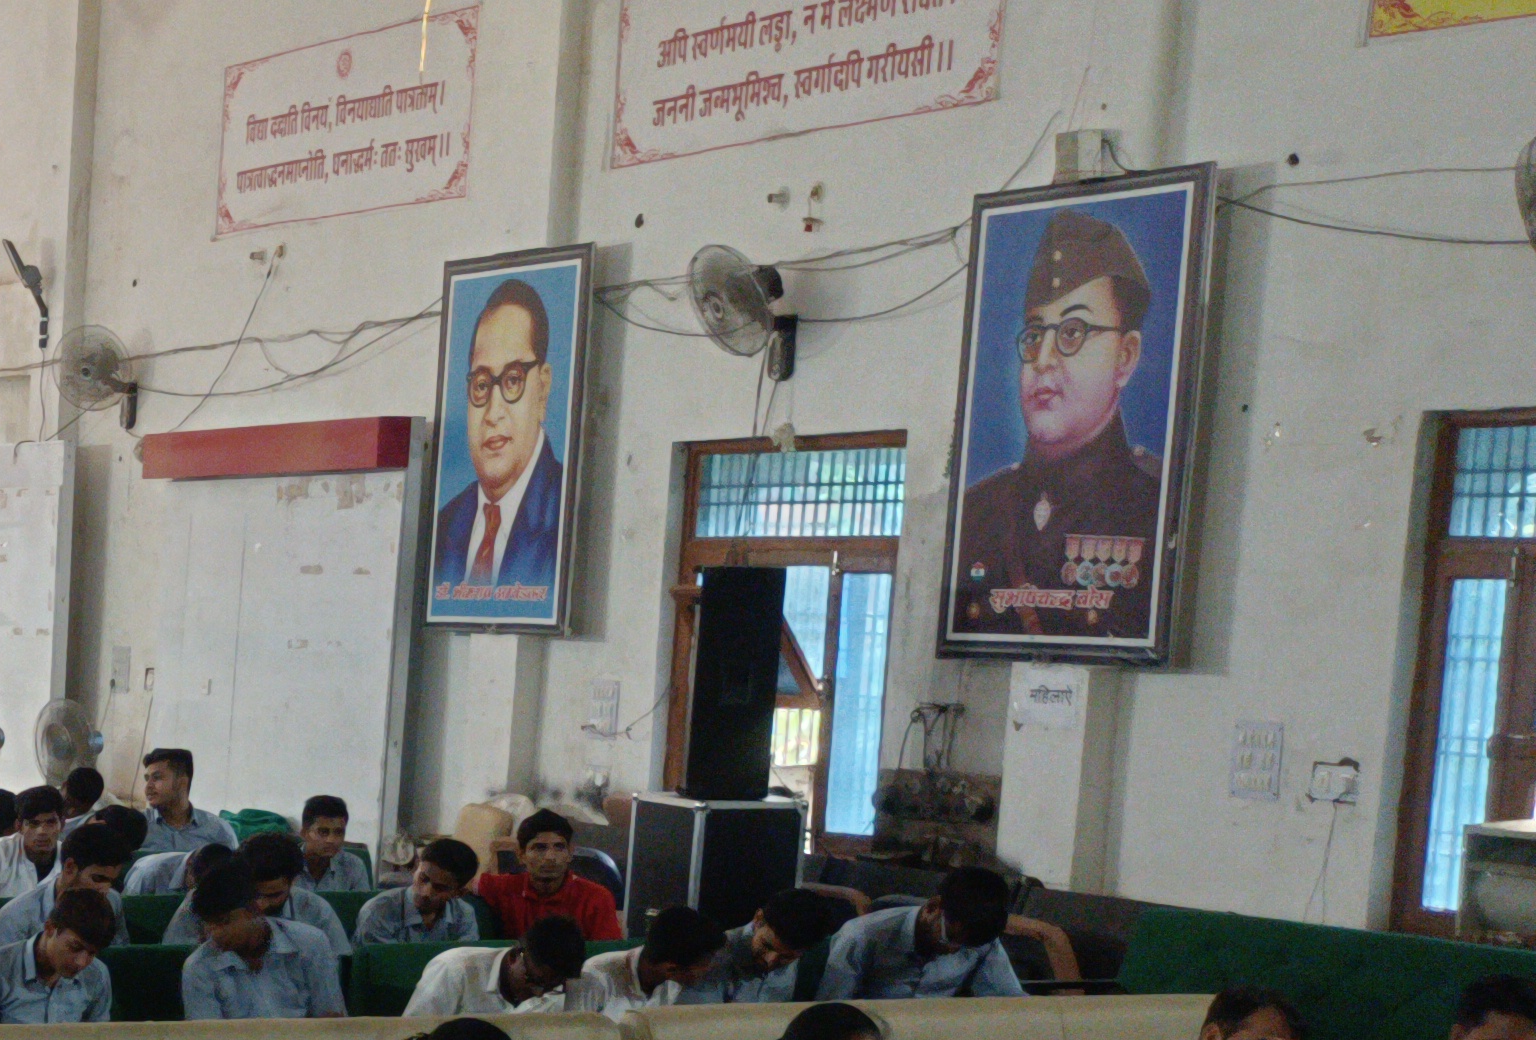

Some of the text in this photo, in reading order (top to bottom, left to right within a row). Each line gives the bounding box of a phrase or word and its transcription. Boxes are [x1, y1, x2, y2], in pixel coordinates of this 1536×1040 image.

[657, 28, 689, 68] अपि
[692, 11, 757, 61] स्वर्णमयी
[652, 84, 697, 127] जननी
[794, 50, 865, 99] स्वर्गादपि
